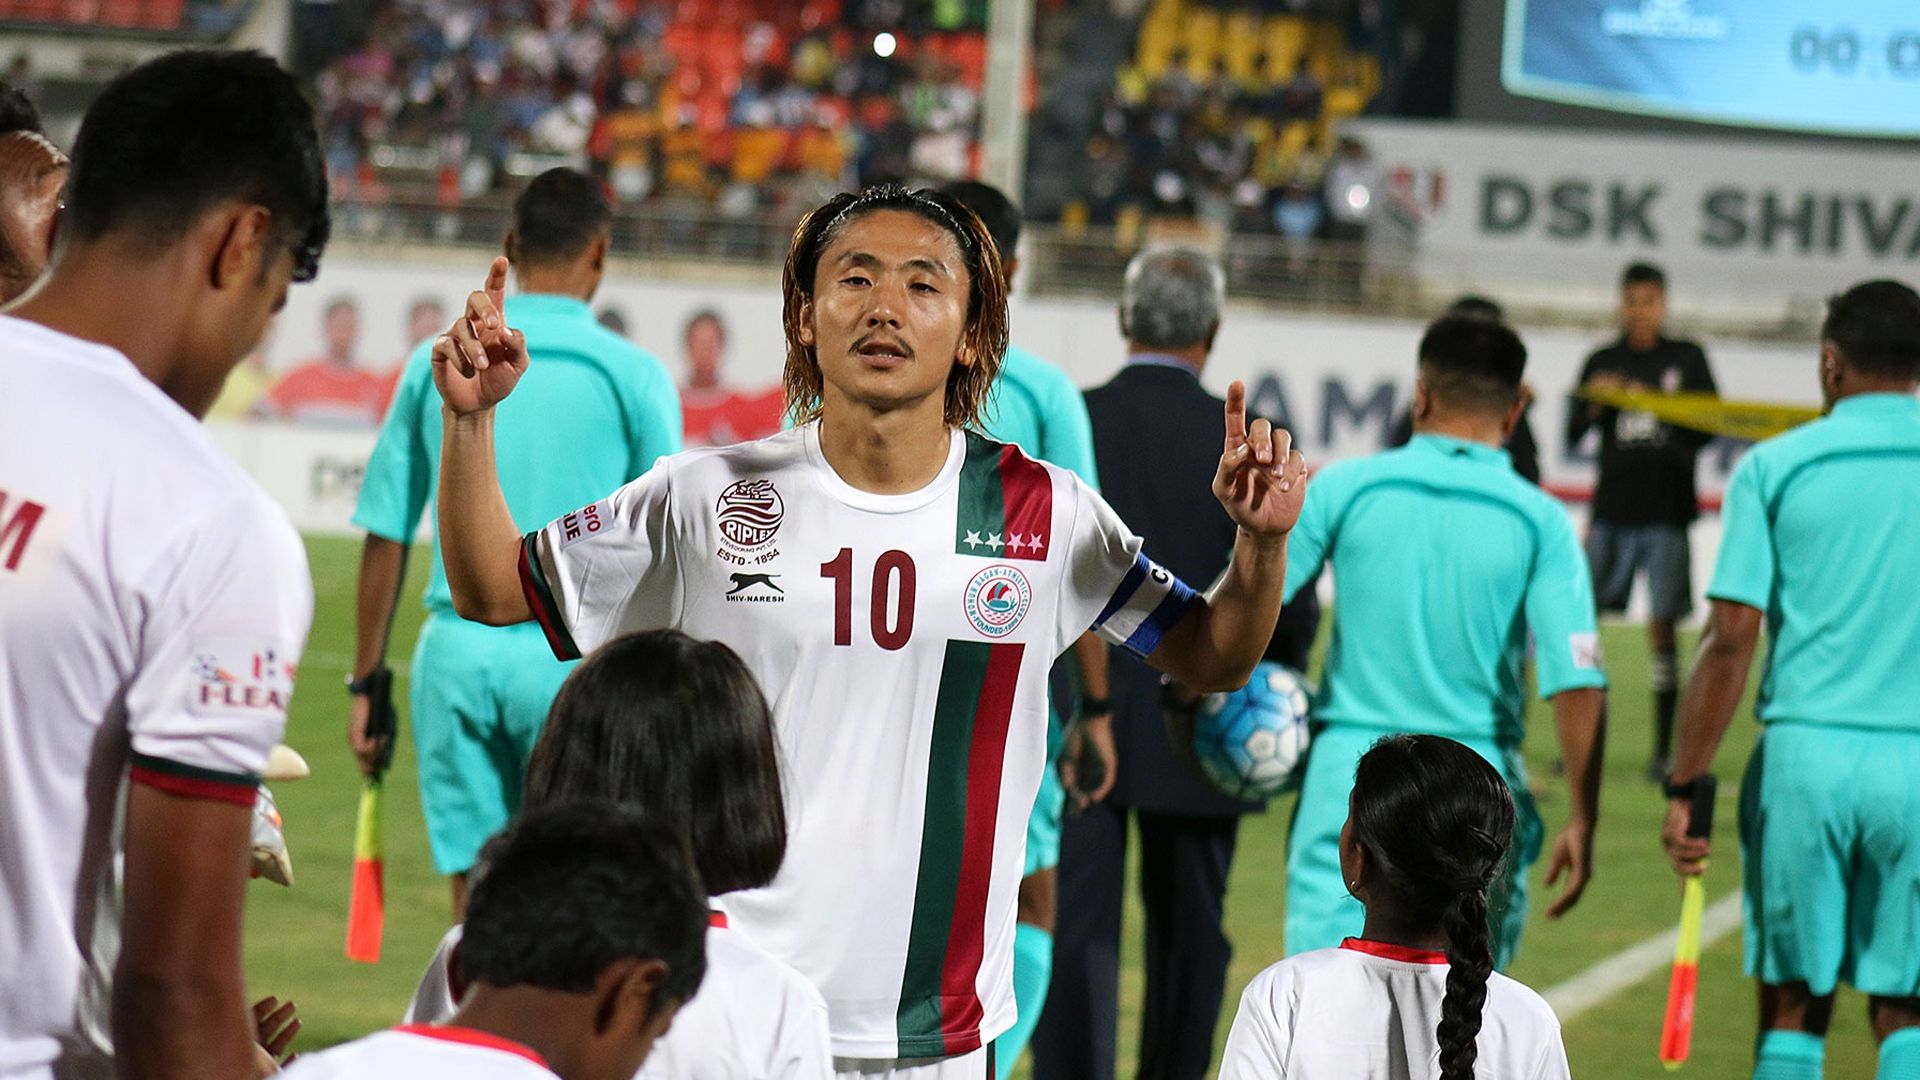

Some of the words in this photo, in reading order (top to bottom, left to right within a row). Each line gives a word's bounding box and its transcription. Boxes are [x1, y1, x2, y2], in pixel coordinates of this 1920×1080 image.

[1480, 175, 1661, 246] DSK
[1701, 187, 1920, 261] SHIV
[563, 511, 581, 541] UE
[726, 521, 776, 543] RIPLEY
[717, 548, 746, 565] ESTD
[754, 548, 780, 565] 1854
[1151, 569, 1169, 584] C
[821, 548, 916, 650] 10
